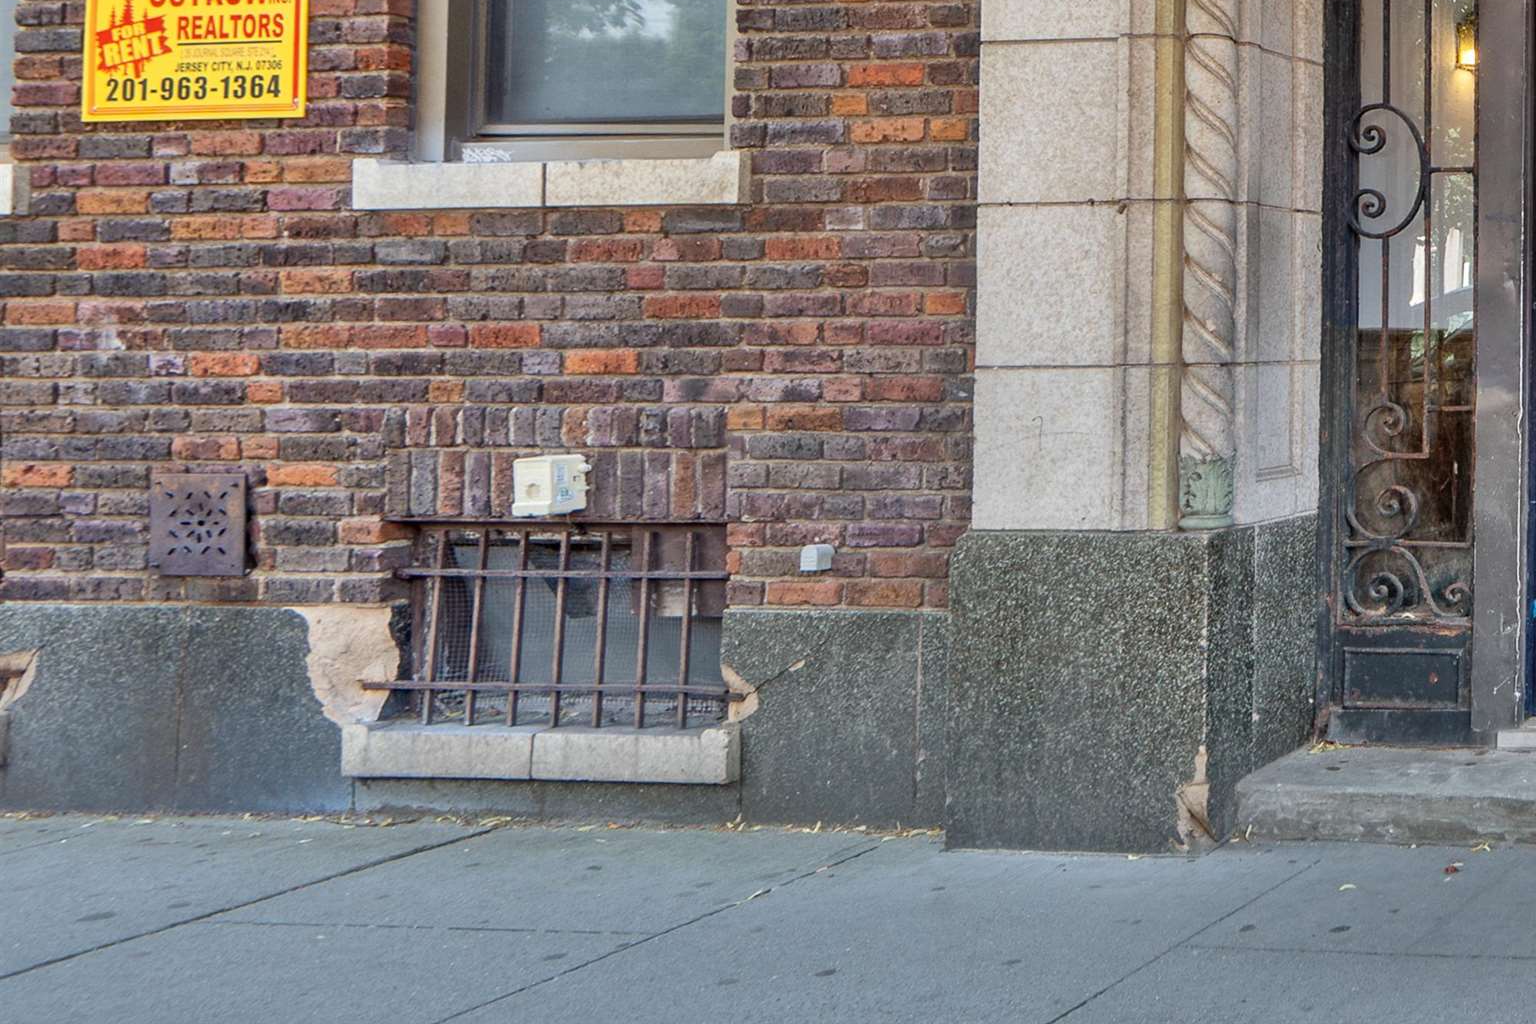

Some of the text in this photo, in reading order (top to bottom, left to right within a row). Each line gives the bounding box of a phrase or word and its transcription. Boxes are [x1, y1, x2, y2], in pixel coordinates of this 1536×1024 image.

[112, 23, 145, 41] FOR
[177, 13, 284, 40] REALTORS
[103, 32, 162, 66] RENT
[174, 61, 208, 73] JERSEY
[106, 75, 281, 102] 201-963-1364
